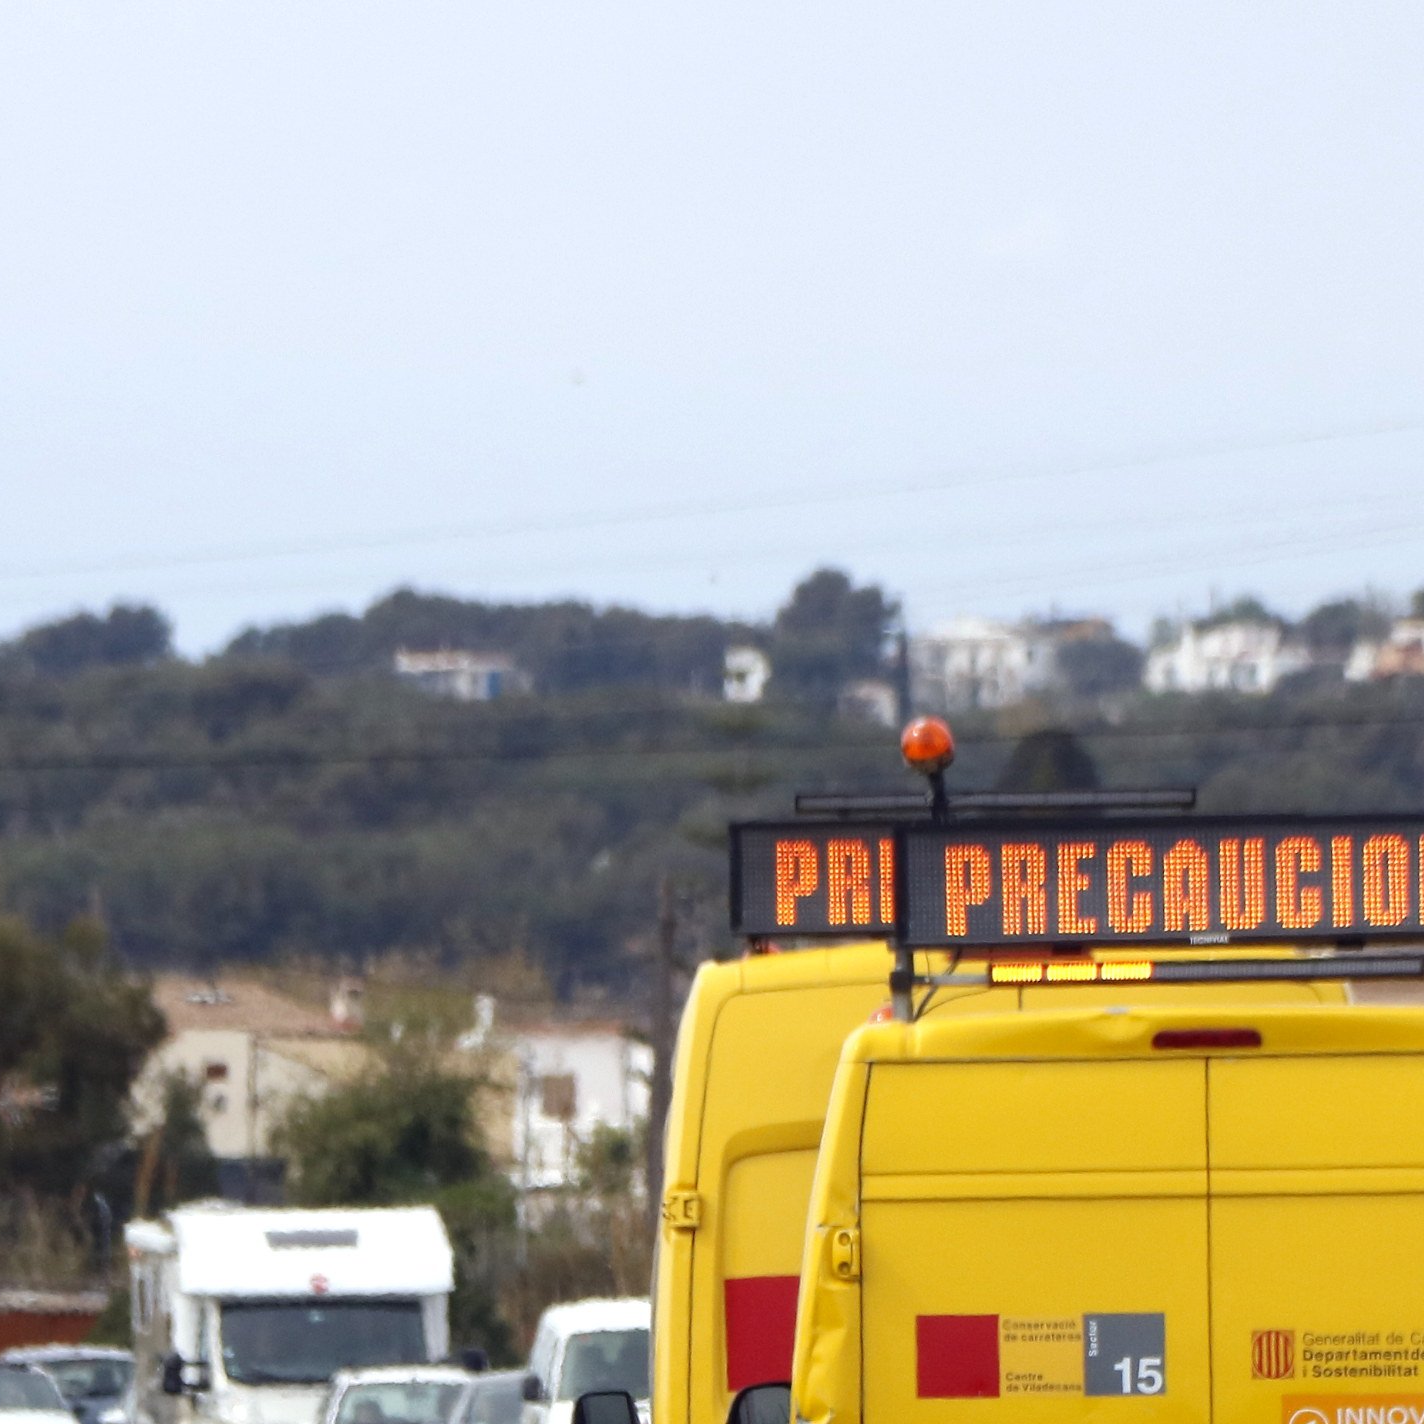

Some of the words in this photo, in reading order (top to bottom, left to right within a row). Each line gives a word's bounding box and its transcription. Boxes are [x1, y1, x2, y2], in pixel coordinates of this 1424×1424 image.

[1004, 1333, 1018, 1342] de
[1302, 1332, 1381, 1346] Generalitat
[1386, 1332, 1403, 1345] de
[1113, 1357, 1164, 1395] 15
[1302, 1366, 1308, 1378] i
[1311, 1365, 1419, 1378] Sostenibilitat
